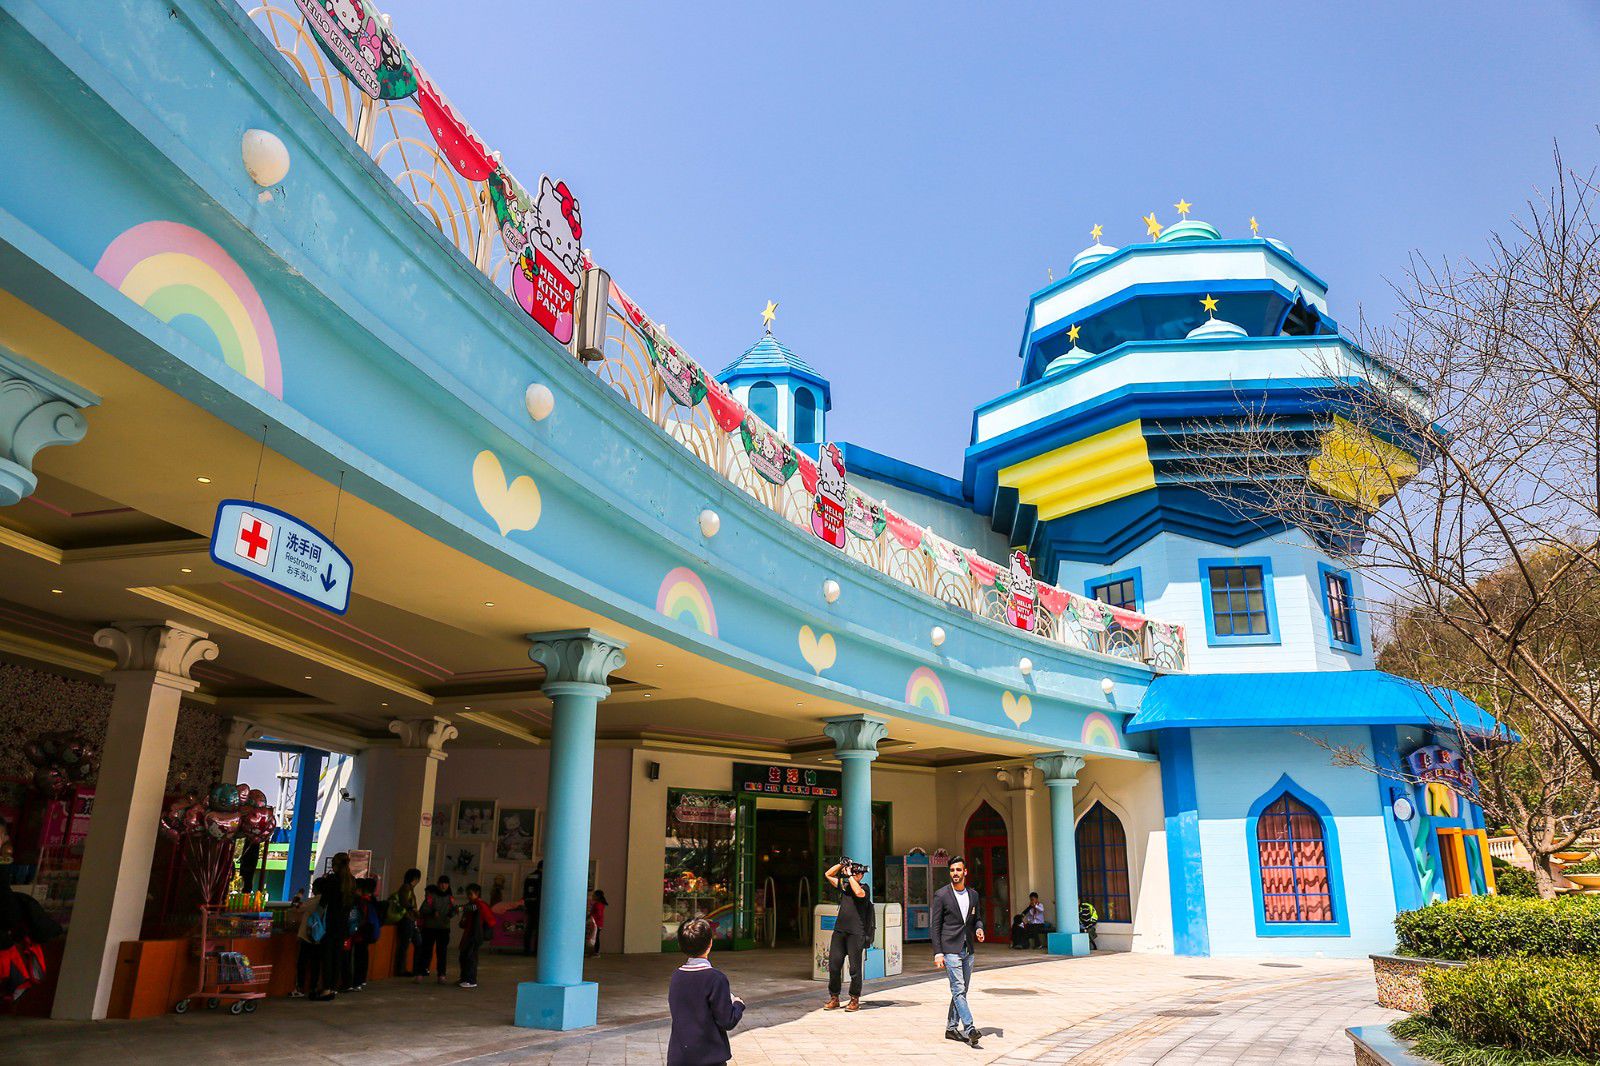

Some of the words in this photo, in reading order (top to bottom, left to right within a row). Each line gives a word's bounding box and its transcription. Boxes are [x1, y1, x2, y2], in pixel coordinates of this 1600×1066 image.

[302, 0, 329, 33] ELLO
[330, 30, 356, 64] KITTY
[355, 61, 378, 94] PARK
[505, 228, 523, 249] HELLO
[538, 278, 566, 309] KITTY
[539, 265, 571, 302] HELLO
[536, 290, 563, 322] PARK
[824, 503, 843, 520] HELLO
[824, 512, 841, 528] KITTY
[286, 531, 322, 563] 洗手间
[285, 552, 318, 574] Restrooms
[286, 565, 313, 582] お手洗い
